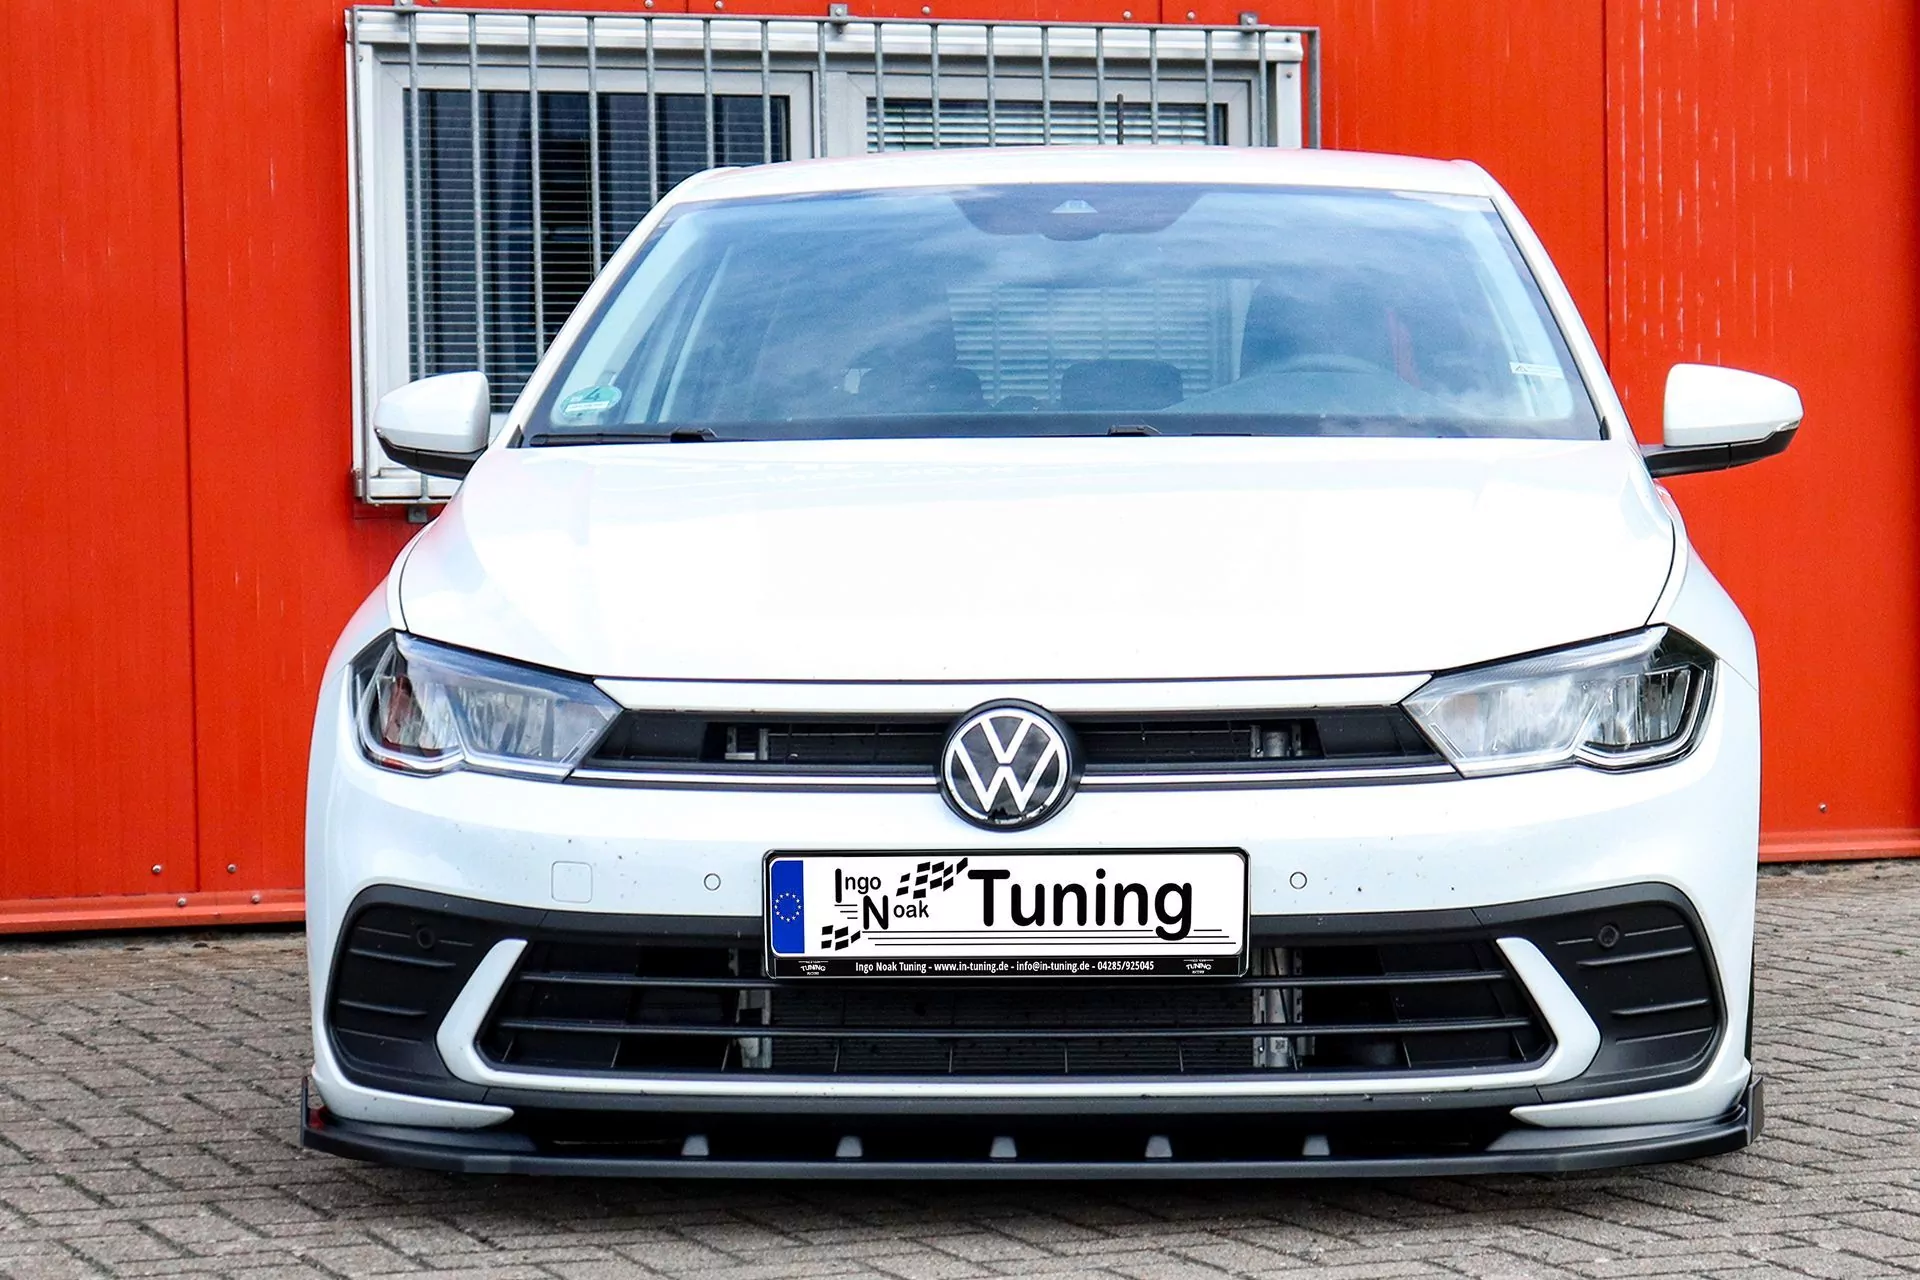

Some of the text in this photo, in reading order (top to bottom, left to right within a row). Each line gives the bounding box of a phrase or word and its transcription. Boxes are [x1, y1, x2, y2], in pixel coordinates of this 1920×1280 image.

[834, 868, 882, 903] Ingo
[862, 895, 930, 930] Noak
[967, 867, 1193, 941] Tuning
[855, 962, 874, 974] Ingo
[875, 961, 898, 972] Noak
[899, 961, 927, 974] Tuning
[934, 961, 1009, 974] www.in-tuning.de
[1016, 960, 1090, 973] info@in-tuning.de
[1097, 960, 1155, 971] 04285/925045
